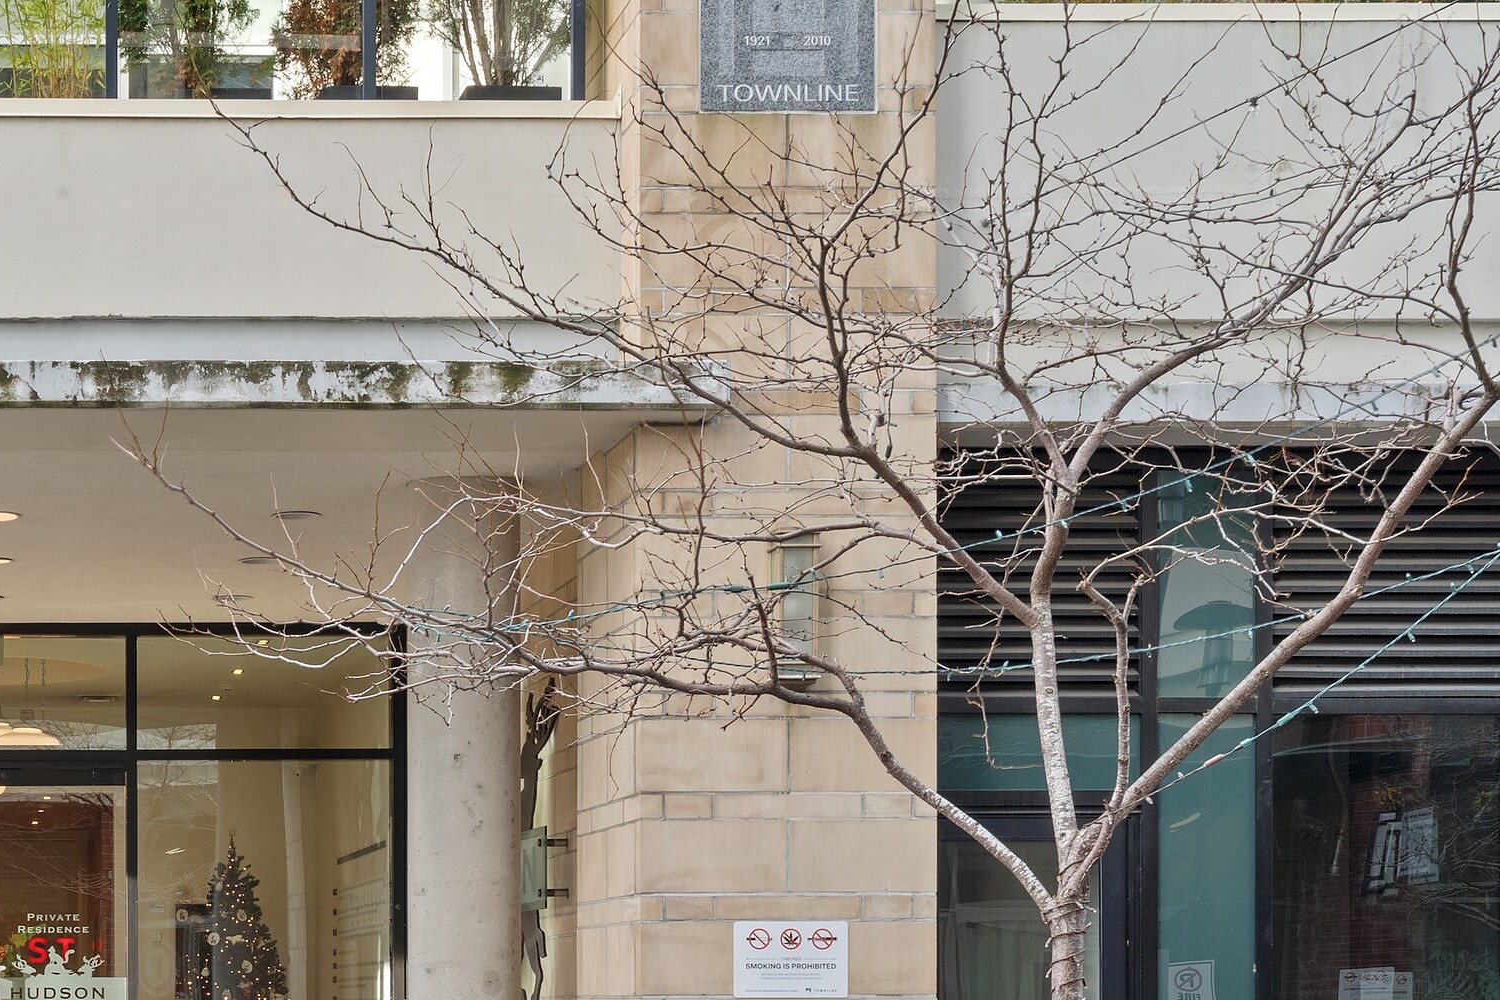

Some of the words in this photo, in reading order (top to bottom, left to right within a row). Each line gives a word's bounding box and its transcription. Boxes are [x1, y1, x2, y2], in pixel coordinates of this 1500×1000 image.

[743, 35, 771, 46] 1921
[803, 35, 832, 46] 2010
[717, 84, 860, 102] TOWNLINE
[26, 912, 80, 922] PRIVATE
[17, 925, 90, 935] RESIDENCE
[745, 962, 782, 970] SMOKING
[783, 962, 791, 970] IS
[791, 962, 837, 970] PROHIBITED
[11, 986, 106, 1000] HUDSON
